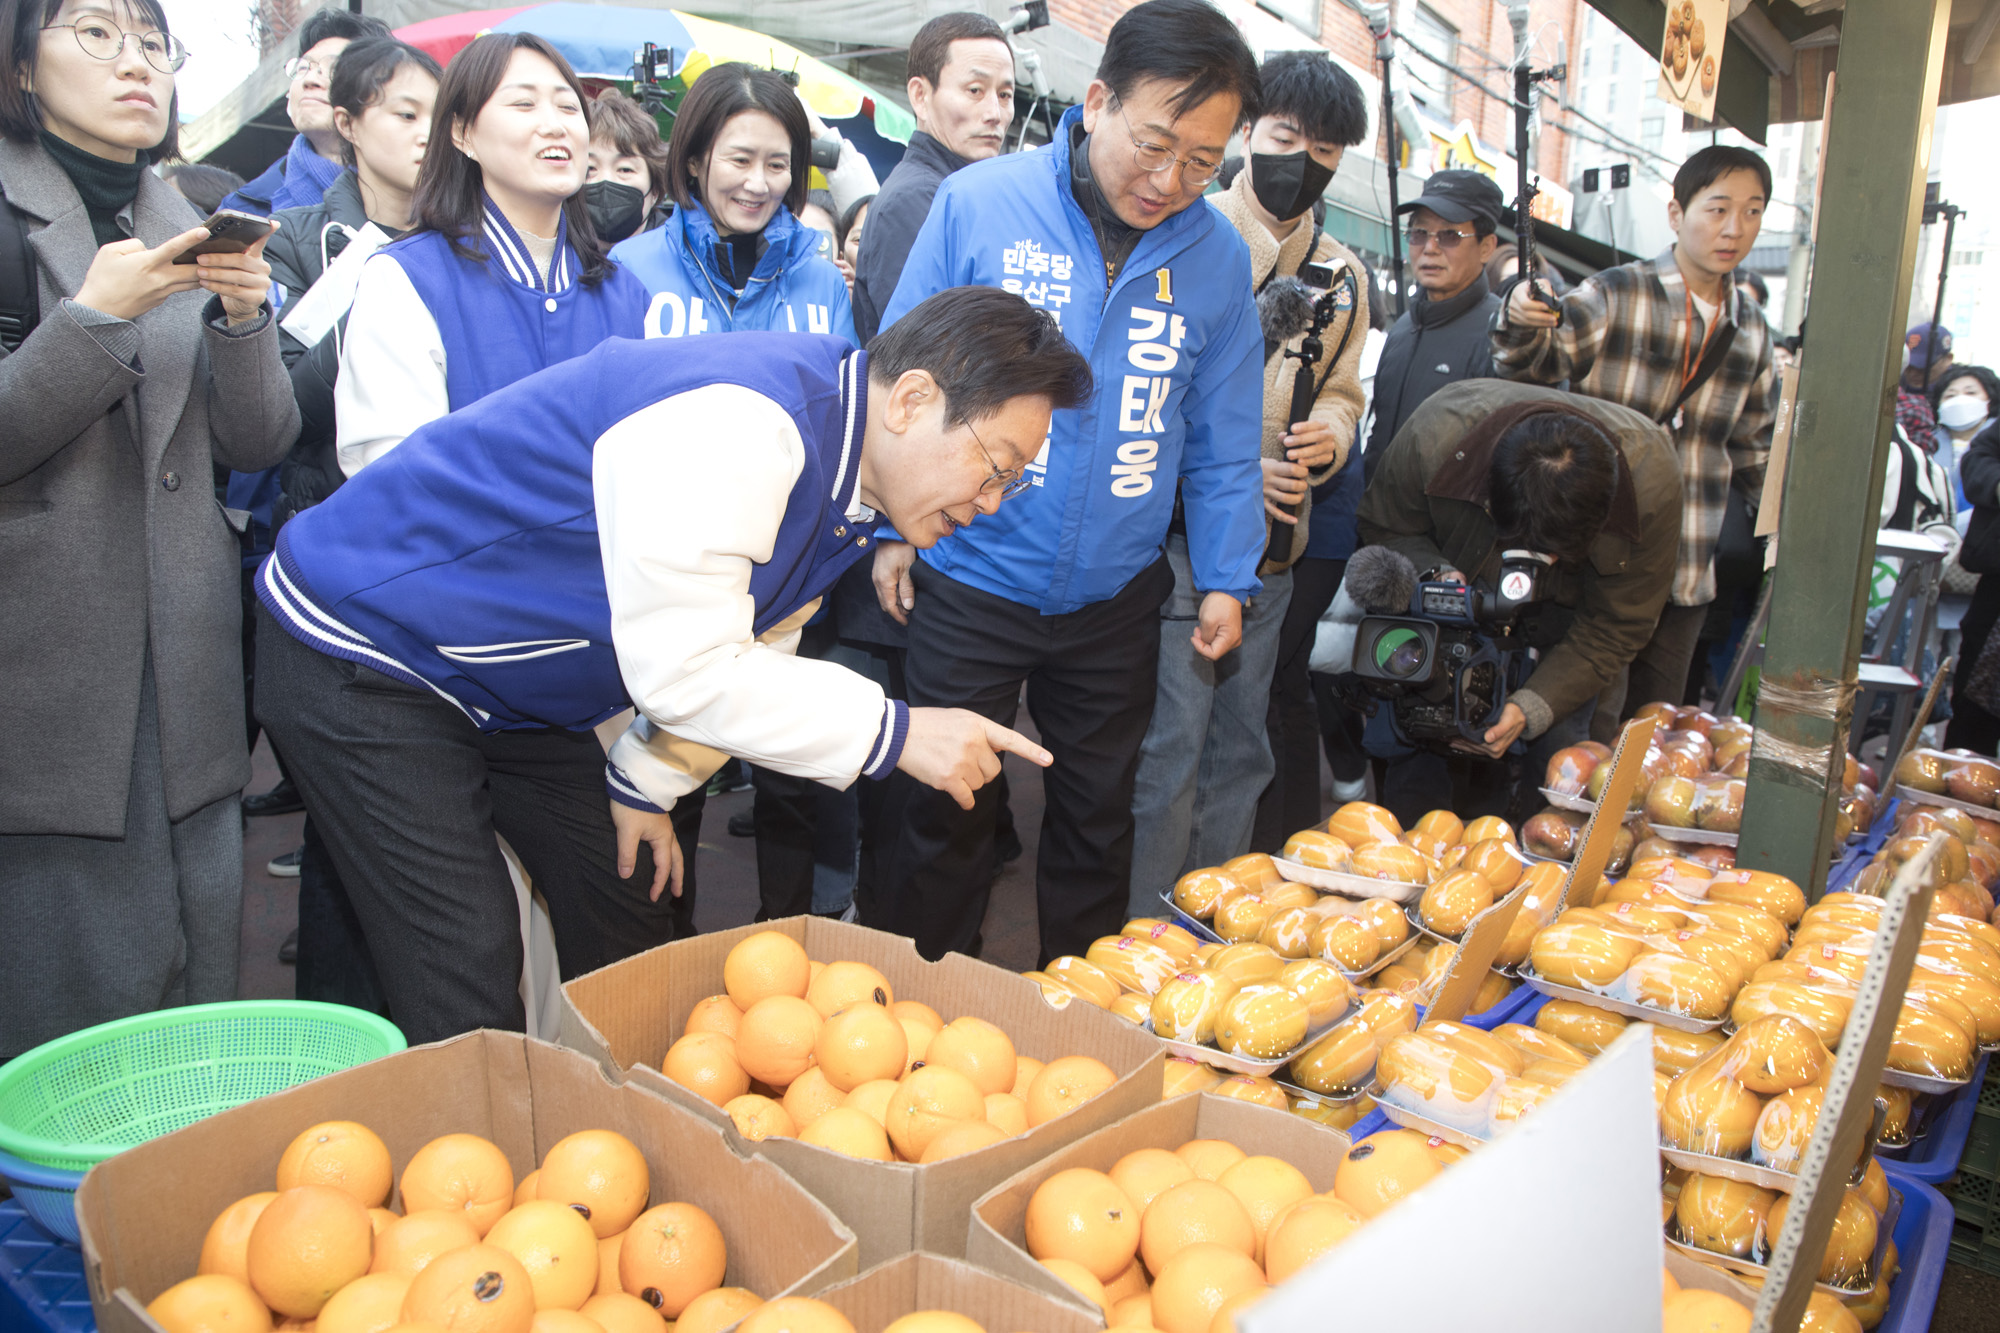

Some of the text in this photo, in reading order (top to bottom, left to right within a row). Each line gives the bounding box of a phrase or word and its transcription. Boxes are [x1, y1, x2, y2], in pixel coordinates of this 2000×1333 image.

[1002, 248, 1074, 281] 민주당
[1155, 267, 1174, 304] 1
[1110, 306, 1187, 498] 강태웅
